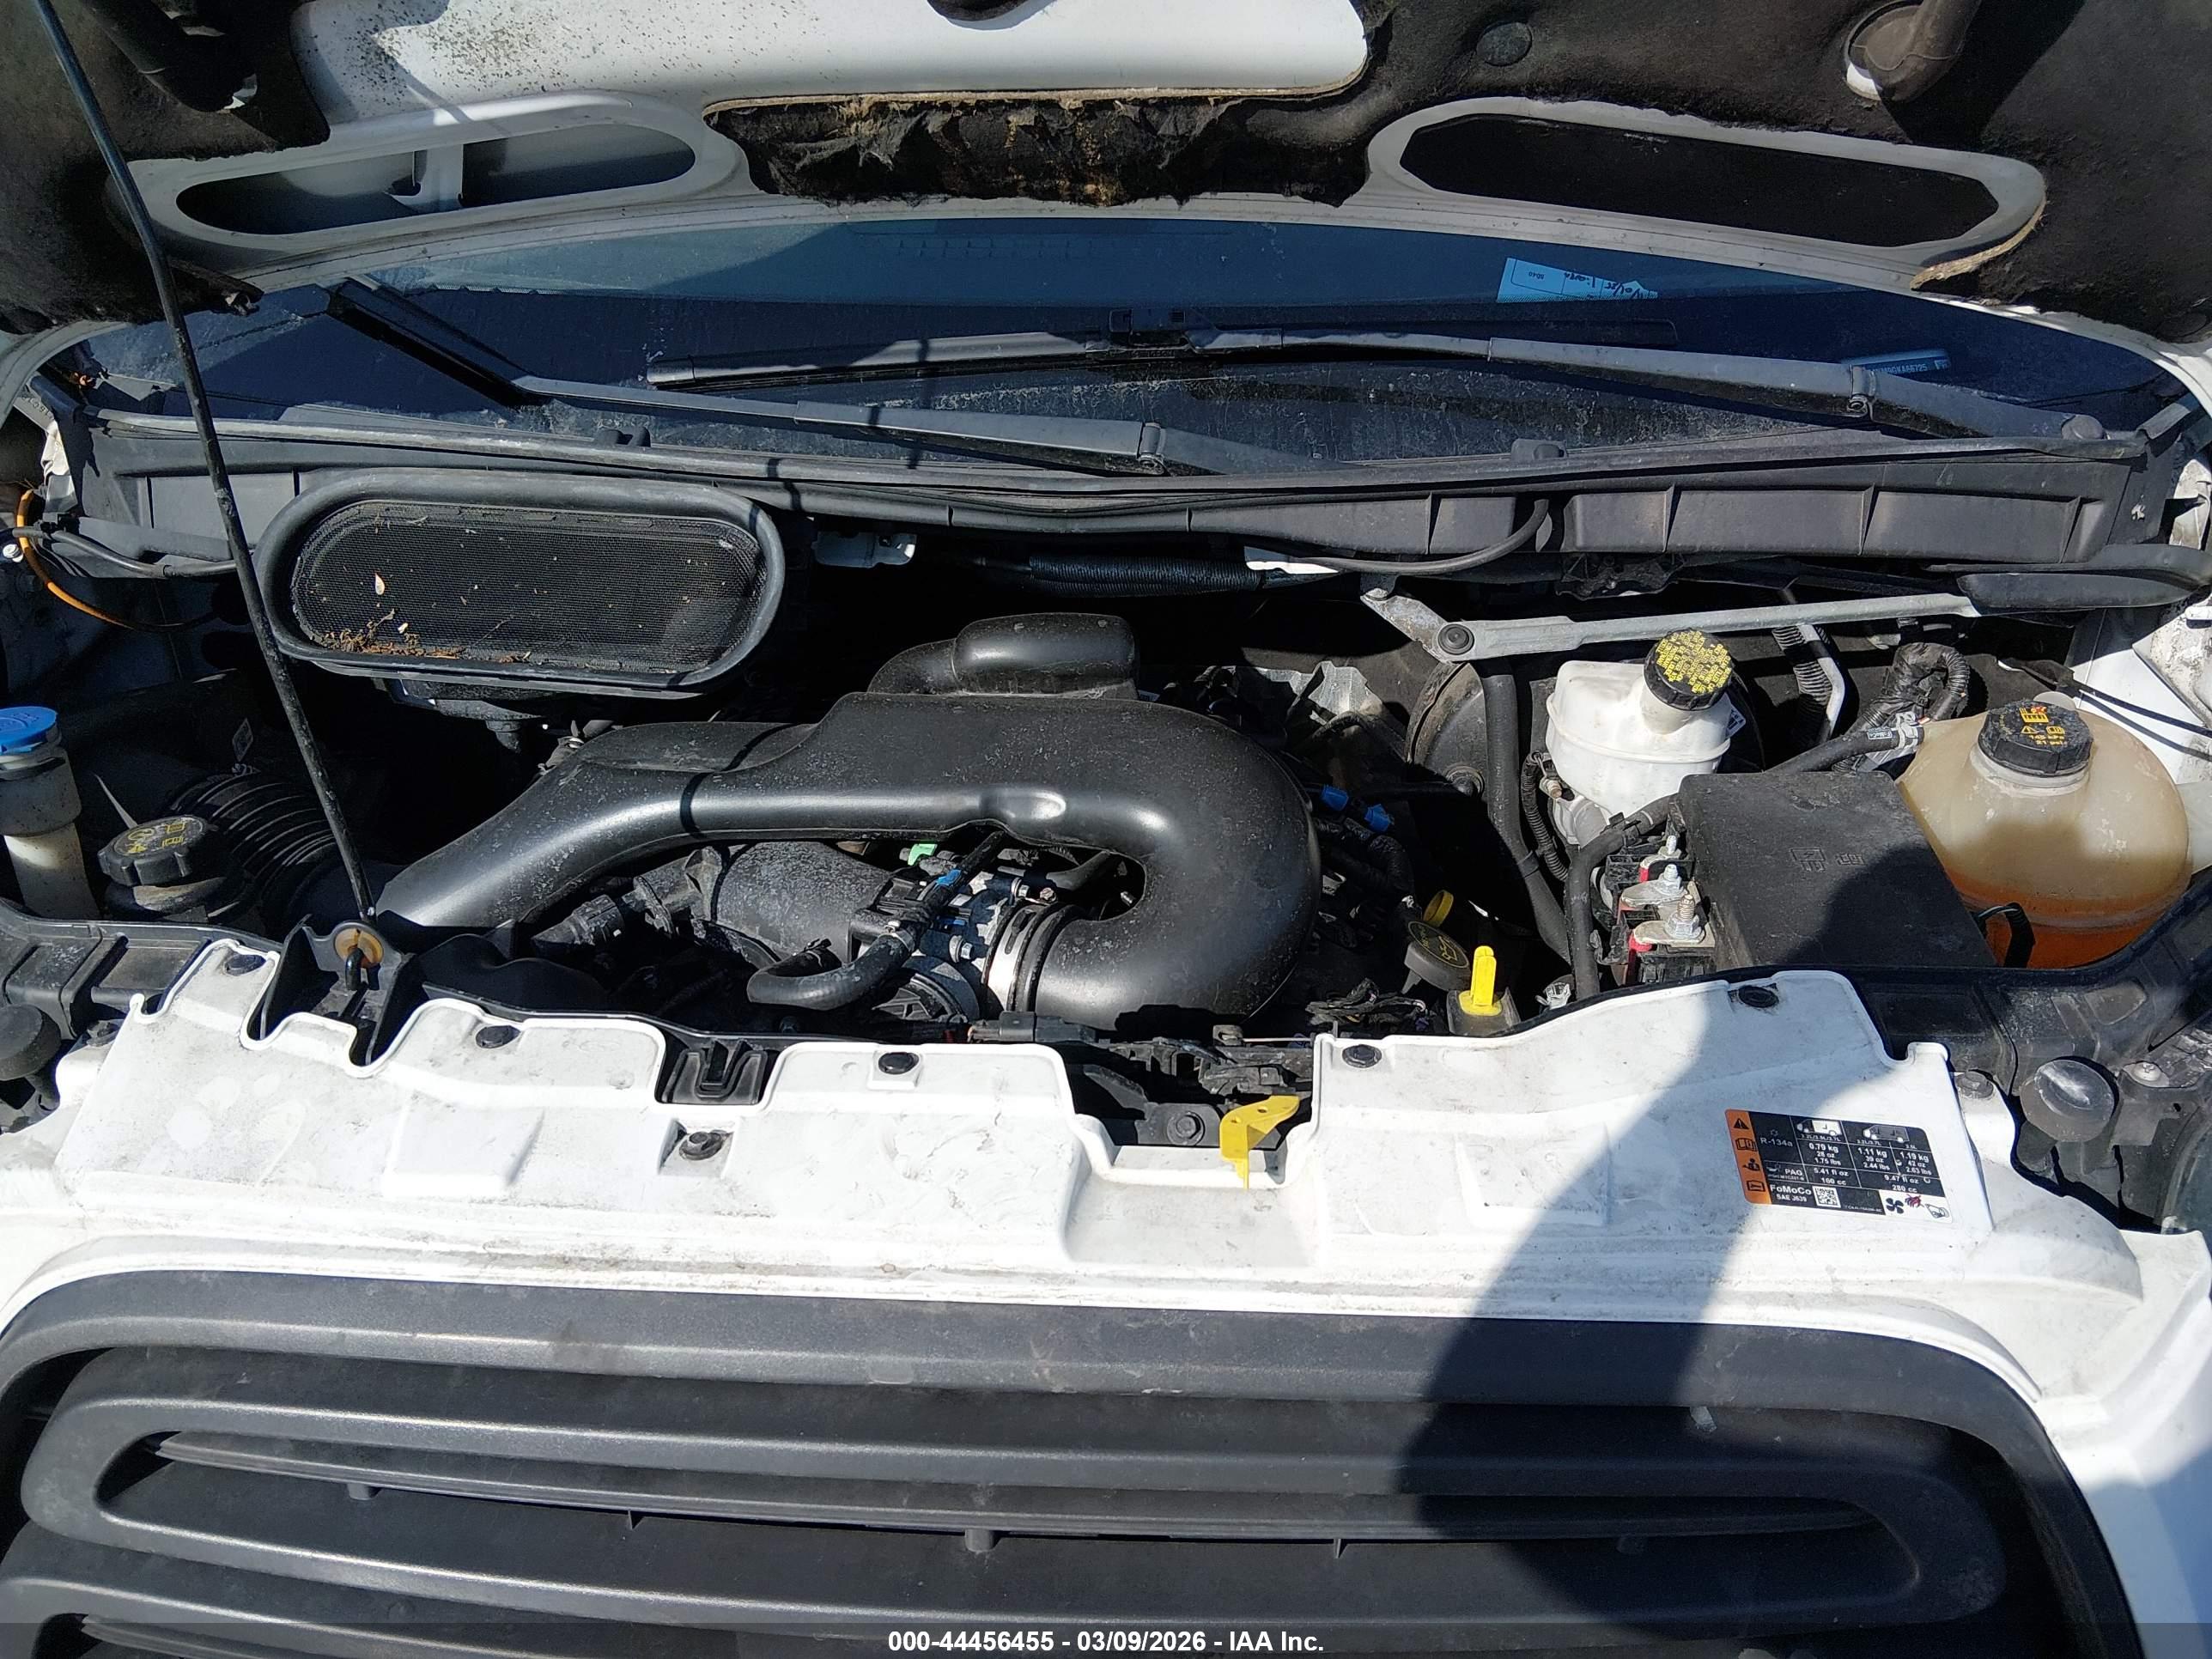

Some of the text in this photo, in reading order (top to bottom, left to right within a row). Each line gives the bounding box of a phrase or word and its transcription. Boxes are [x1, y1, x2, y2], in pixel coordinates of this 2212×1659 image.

[1760, 1137, 1793, 1147] R-134a
[1827, 1144, 1838, 1153] kg
[1876, 1149, 1887, 1158] kg
[1918, 1153, 1929, 1164] kg
[1770, 1184, 1812, 1195] FoMoCo
